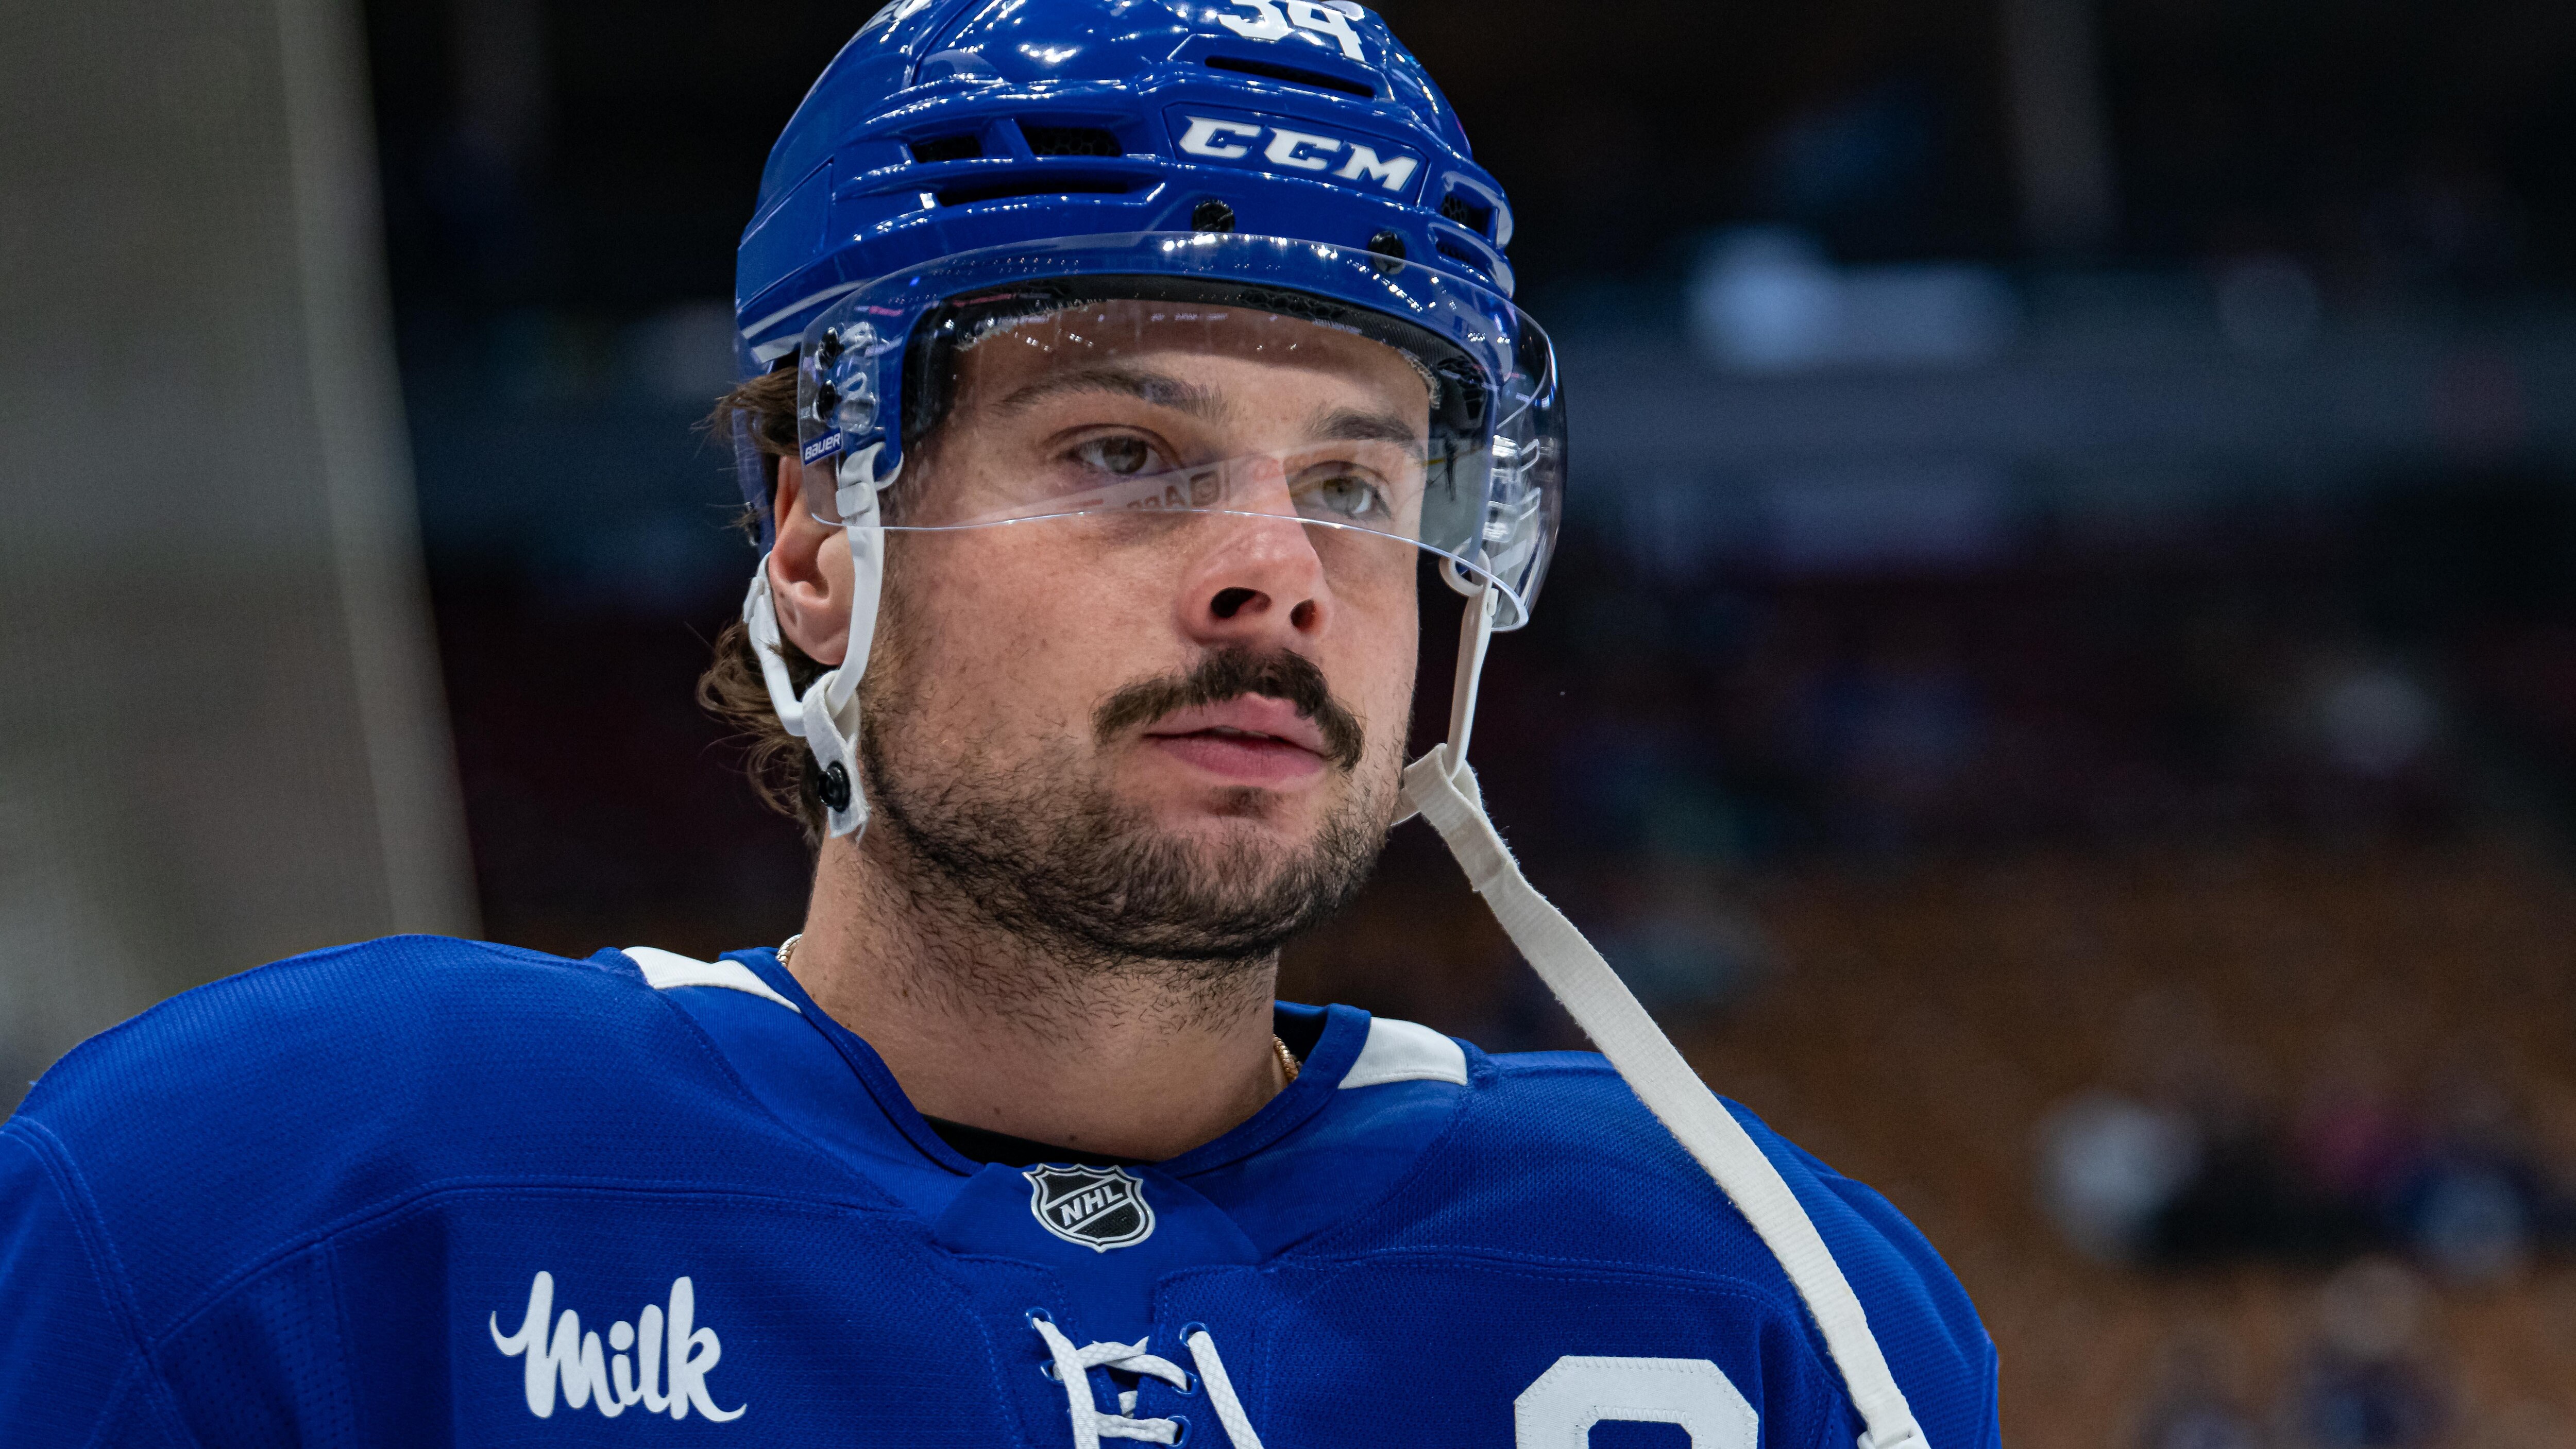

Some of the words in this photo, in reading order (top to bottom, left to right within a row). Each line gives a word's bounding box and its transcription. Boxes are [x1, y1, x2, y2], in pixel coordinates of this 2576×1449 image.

[1179, 116, 1418, 191] CCM
[1059, 1185, 1124, 1226] NHL
[489, 1271, 747, 1422] Milk
